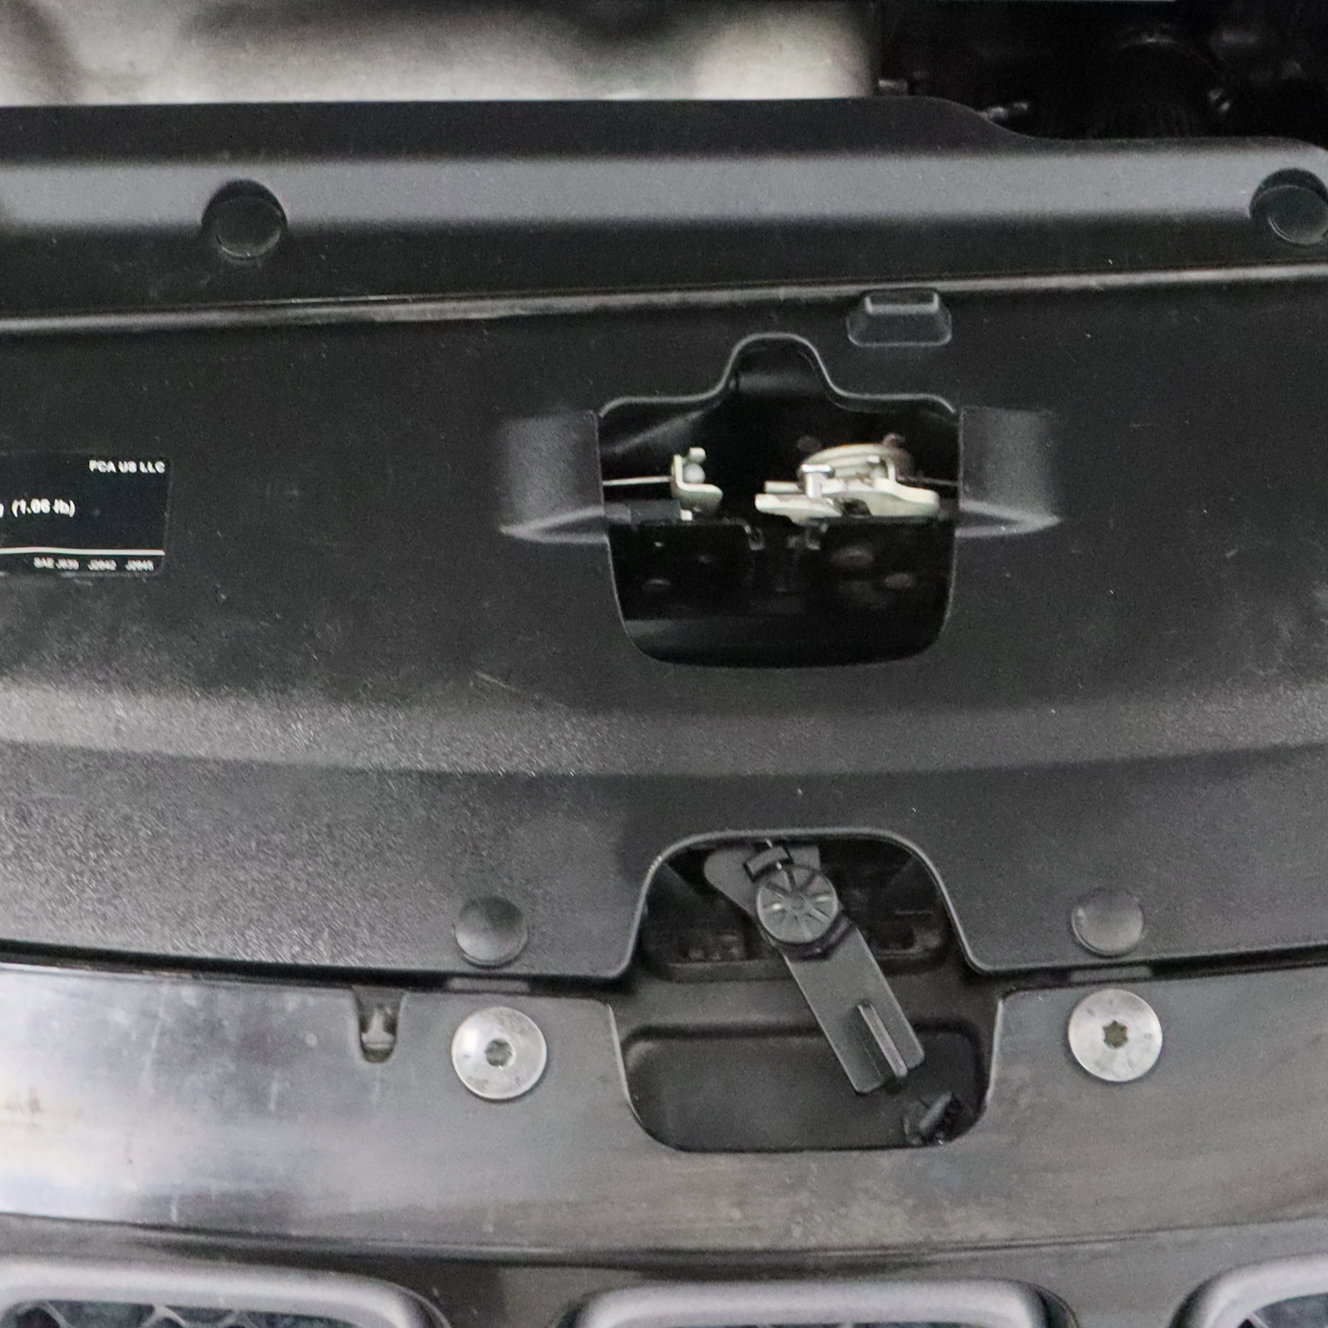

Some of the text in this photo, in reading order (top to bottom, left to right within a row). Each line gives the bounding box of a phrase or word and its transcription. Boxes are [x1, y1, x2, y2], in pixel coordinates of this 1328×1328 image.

[88, 460, 165, 473] FCA US LLC
[53, 498, 76, 518] lb)
